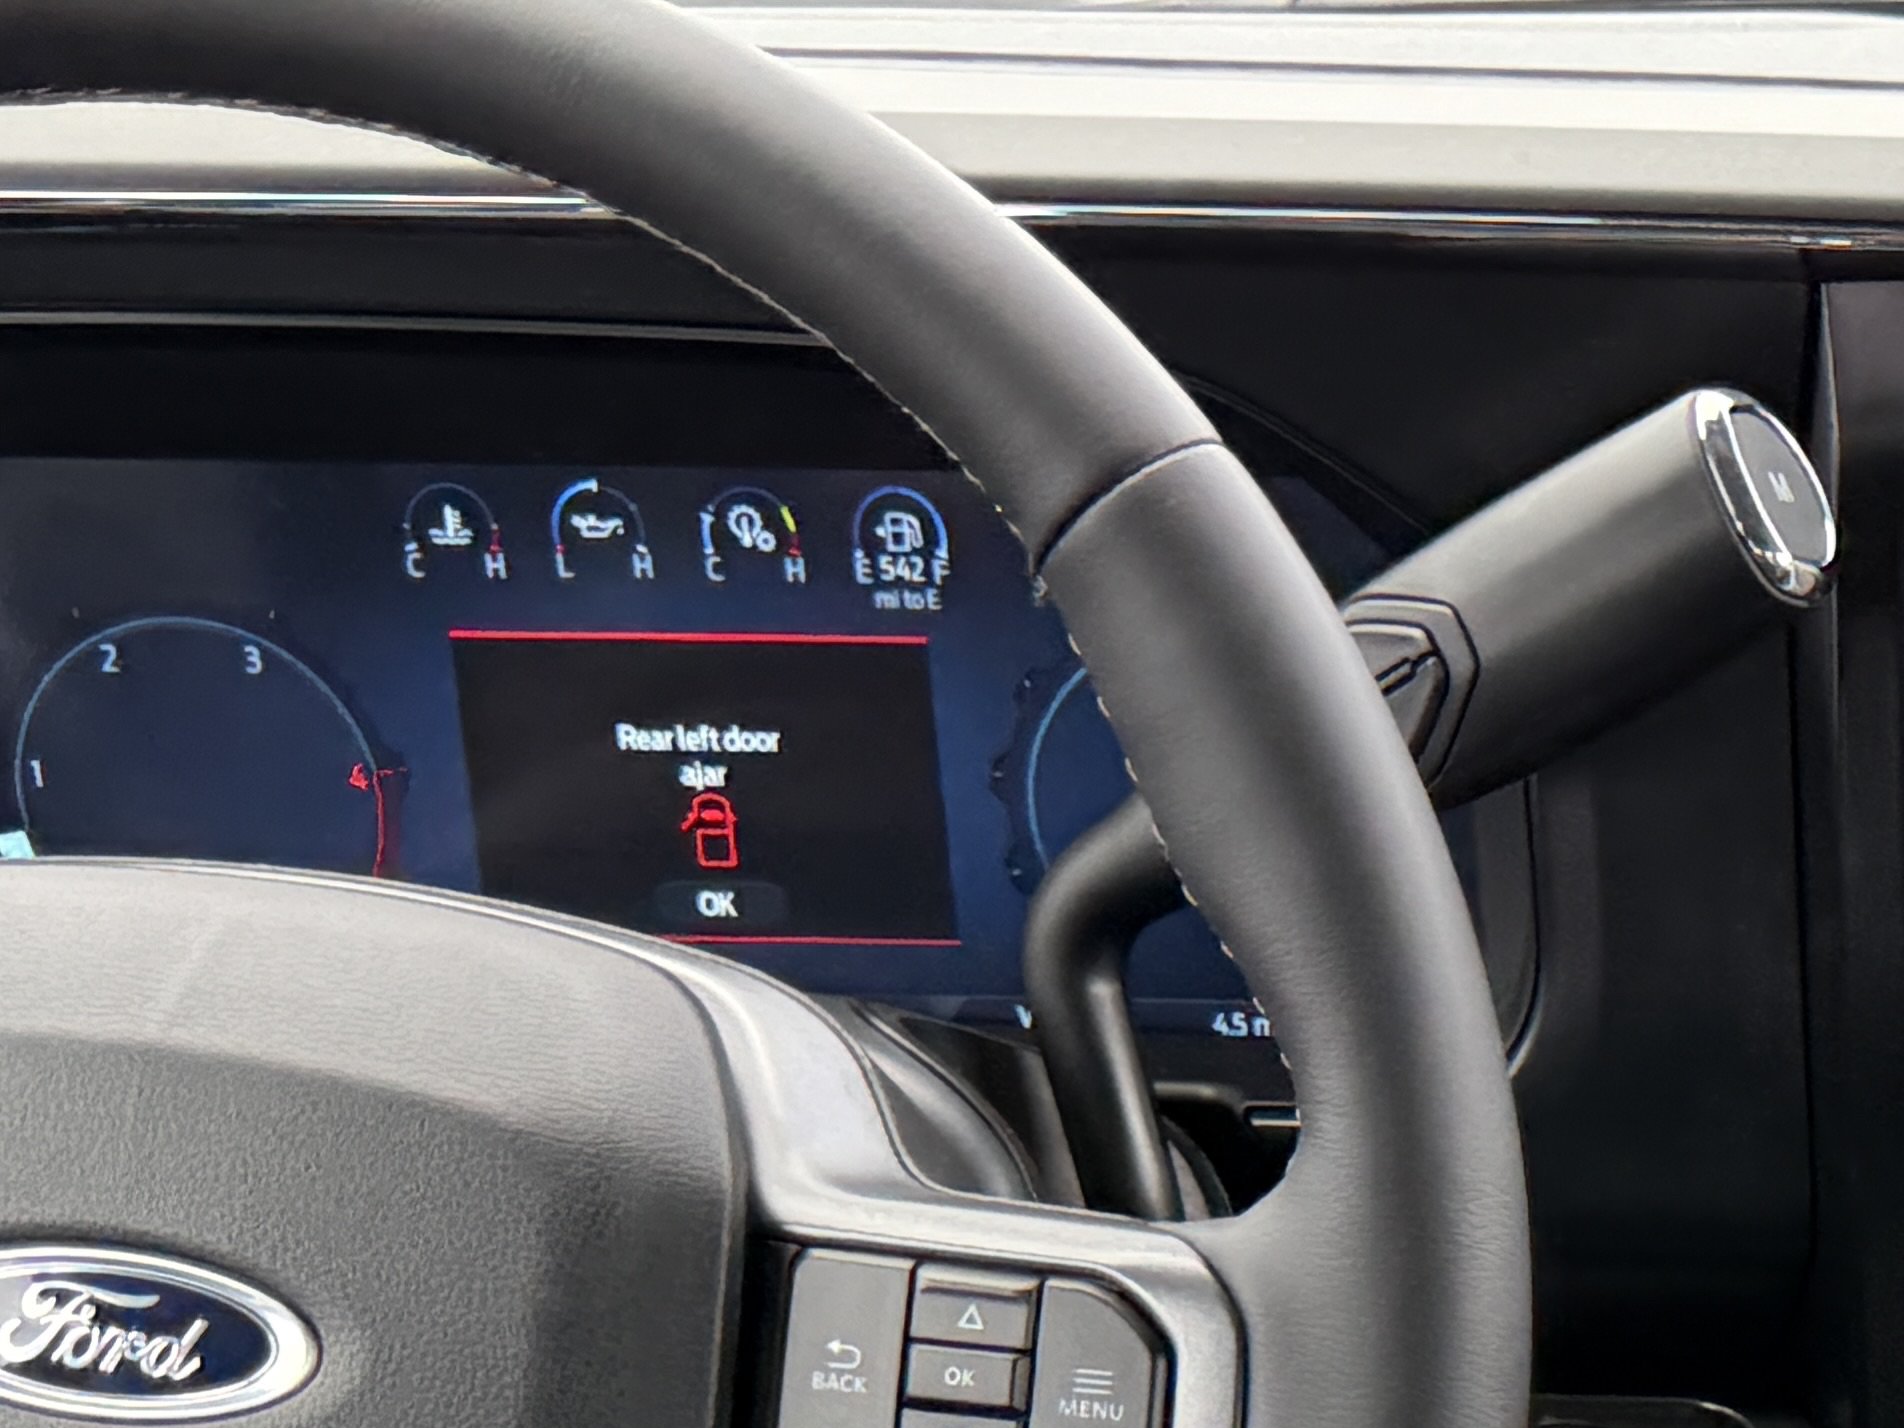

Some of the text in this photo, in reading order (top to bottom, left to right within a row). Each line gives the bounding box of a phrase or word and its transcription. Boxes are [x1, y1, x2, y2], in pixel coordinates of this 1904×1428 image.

[406, 555, 426, 579] C
[485, 553, 507, 580] H
[556, 554, 574, 579] L
[633, 555, 654, 579] H
[706, 556, 726, 581] C
[785, 556, 806, 583] H
[854, 556, 951, 585] E 542 F
[99, 643, 121, 674] 2
[244, 644, 263, 675] 3
[615, 723, 780, 754] Rear left door
[30, 759, 44, 788] 1
[679, 761, 728, 791] ajar
[697, 891, 738, 919] OK
[2, 1280, 209, 1381] Ford
[812, 1371, 868, 1394] BACK
[944, 1367, 976, 1388] OK
[1058, 1399, 1125, 1422] MENU
